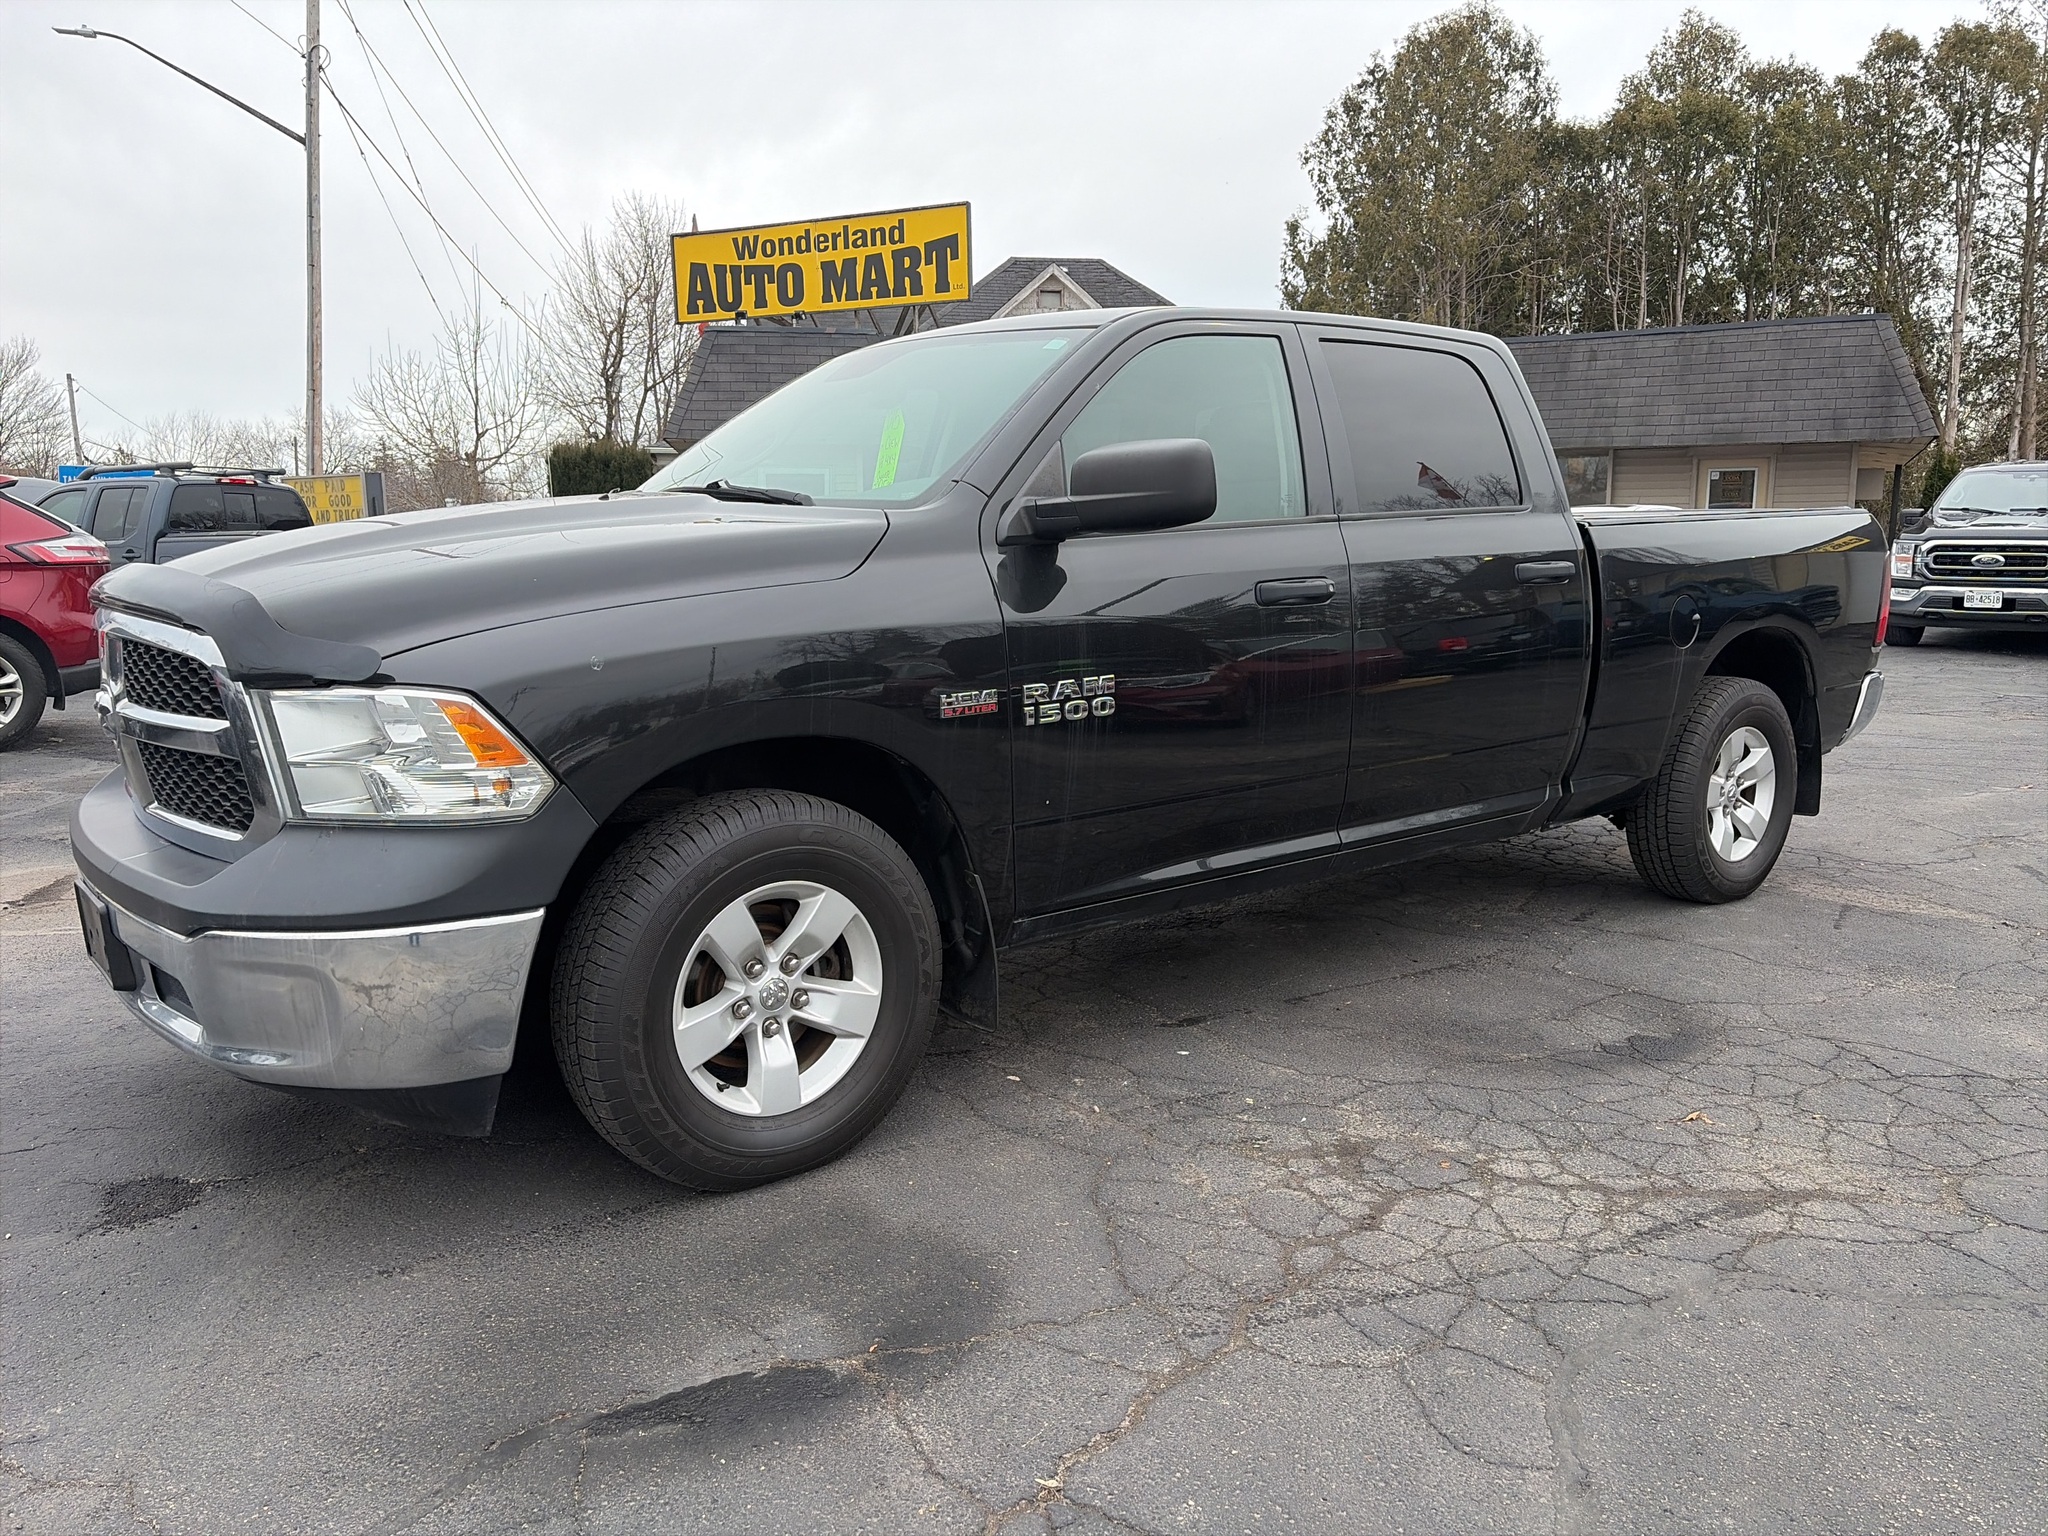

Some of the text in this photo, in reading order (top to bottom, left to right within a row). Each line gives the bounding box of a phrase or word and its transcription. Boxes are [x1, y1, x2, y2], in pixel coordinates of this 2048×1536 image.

[732, 219, 905, 260] Wonderland
[687, 233, 959, 314] AUTO MART
[294, 479, 345, 494] CASH PAID
[328, 494, 351, 507] GOOD
[316, 509, 330, 522] AND
[1023, 674, 1115, 703] RAM
[940, 689, 998, 707] HEMI
[944, 703, 997, 717] 5.7 LITER
[1023, 697, 1116, 726] 1500
